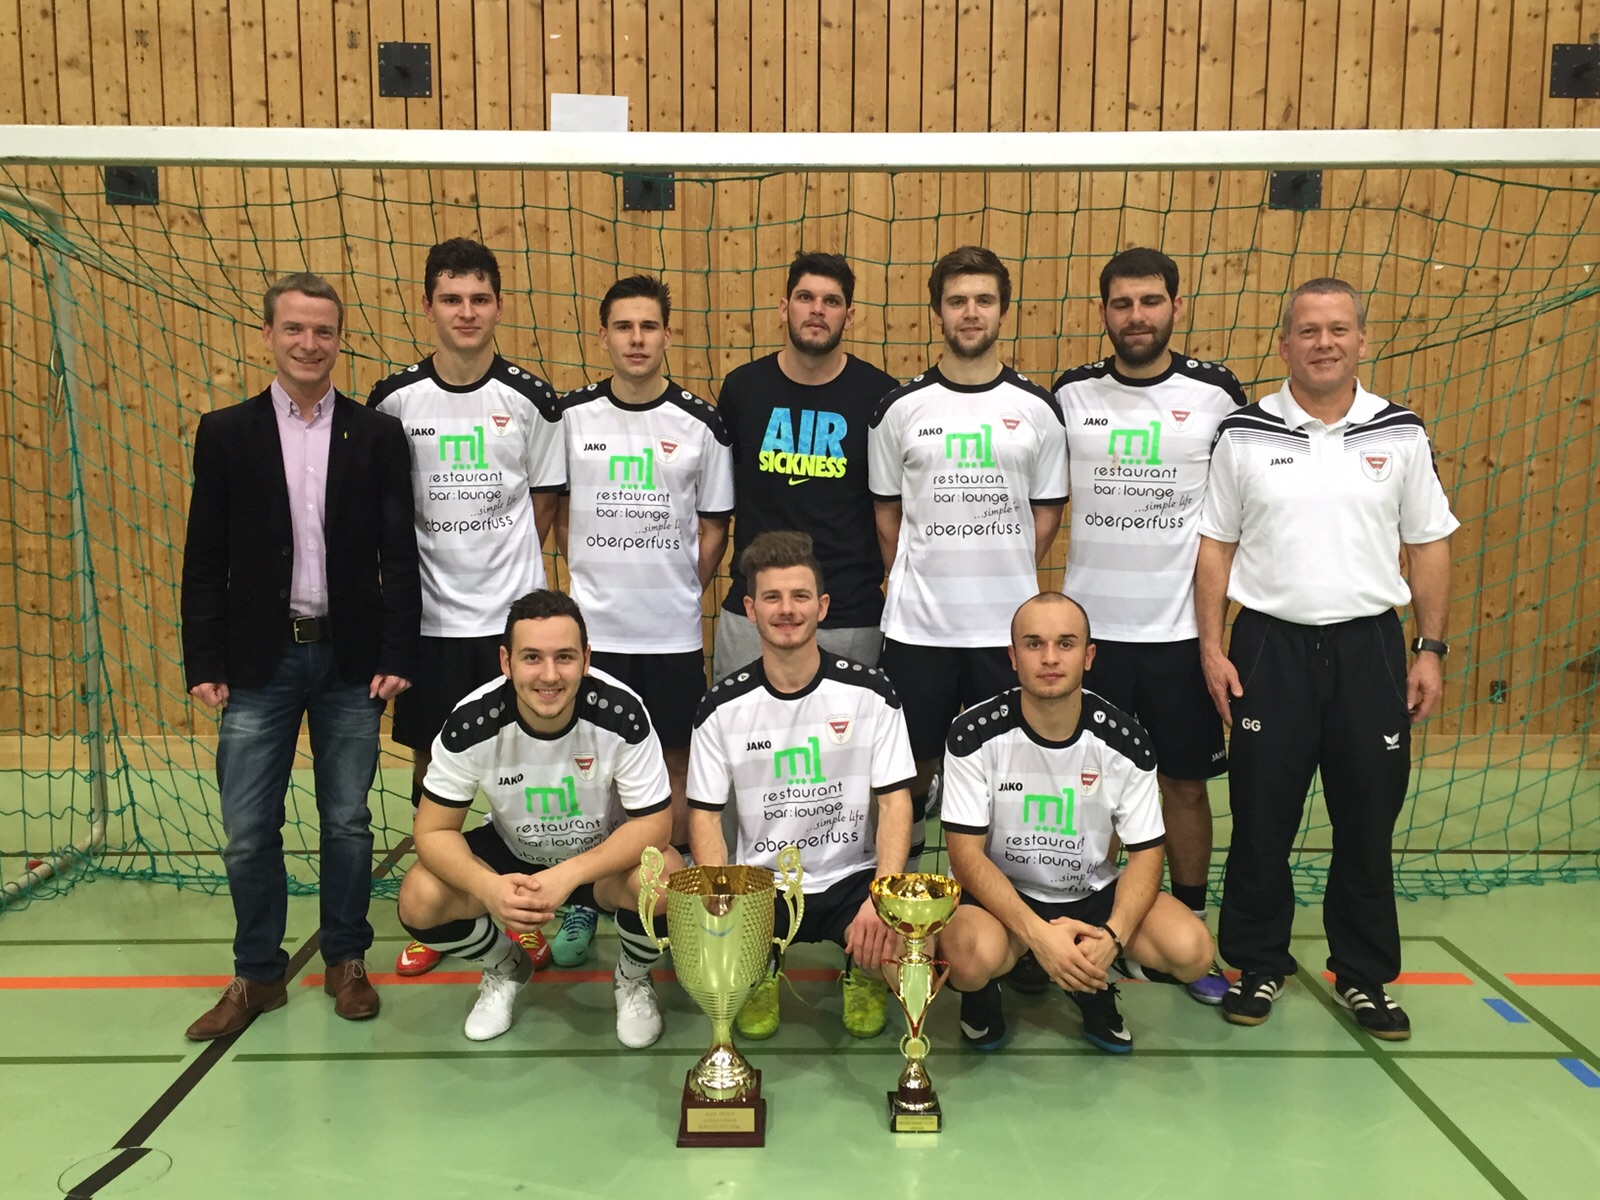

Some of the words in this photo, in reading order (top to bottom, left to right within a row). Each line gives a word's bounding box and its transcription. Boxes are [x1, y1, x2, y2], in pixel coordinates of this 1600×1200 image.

[1083, 417, 1108, 426] JAKO
[411, 427, 436, 437] JAKO
[760, 407, 848, 458] AIR
[917, 427, 943, 437] JAKO
[583, 443, 607, 452] JAKO
[759, 450, 848, 478] SICKNESS
[1269, 457, 1294, 466] JAKO
[428, 471, 504, 483] restaurant
[933, 473, 1005, 485] restauran
[1094, 466, 1177, 479] restaurant
[596, 490, 670, 503] restaurant
[424, 515, 514, 534] oberperfuss
[1085, 512, 1184, 531] oberperfuss
[925, 521, 1022, 538] oberperfuss
[586, 534, 680, 551] oberperfuss
[1241, 717, 1262, 732] GG
[746, 740, 772, 751] JAKO
[498, 773, 524, 786] JAKO
[763, 781, 843, 803] restaurant
[998, 782, 1023, 792] JAKO
[849, 809, 865, 827] life
[516, 819, 601, 833] restaurant
[1005, 851, 1083, 872] bar:loung
